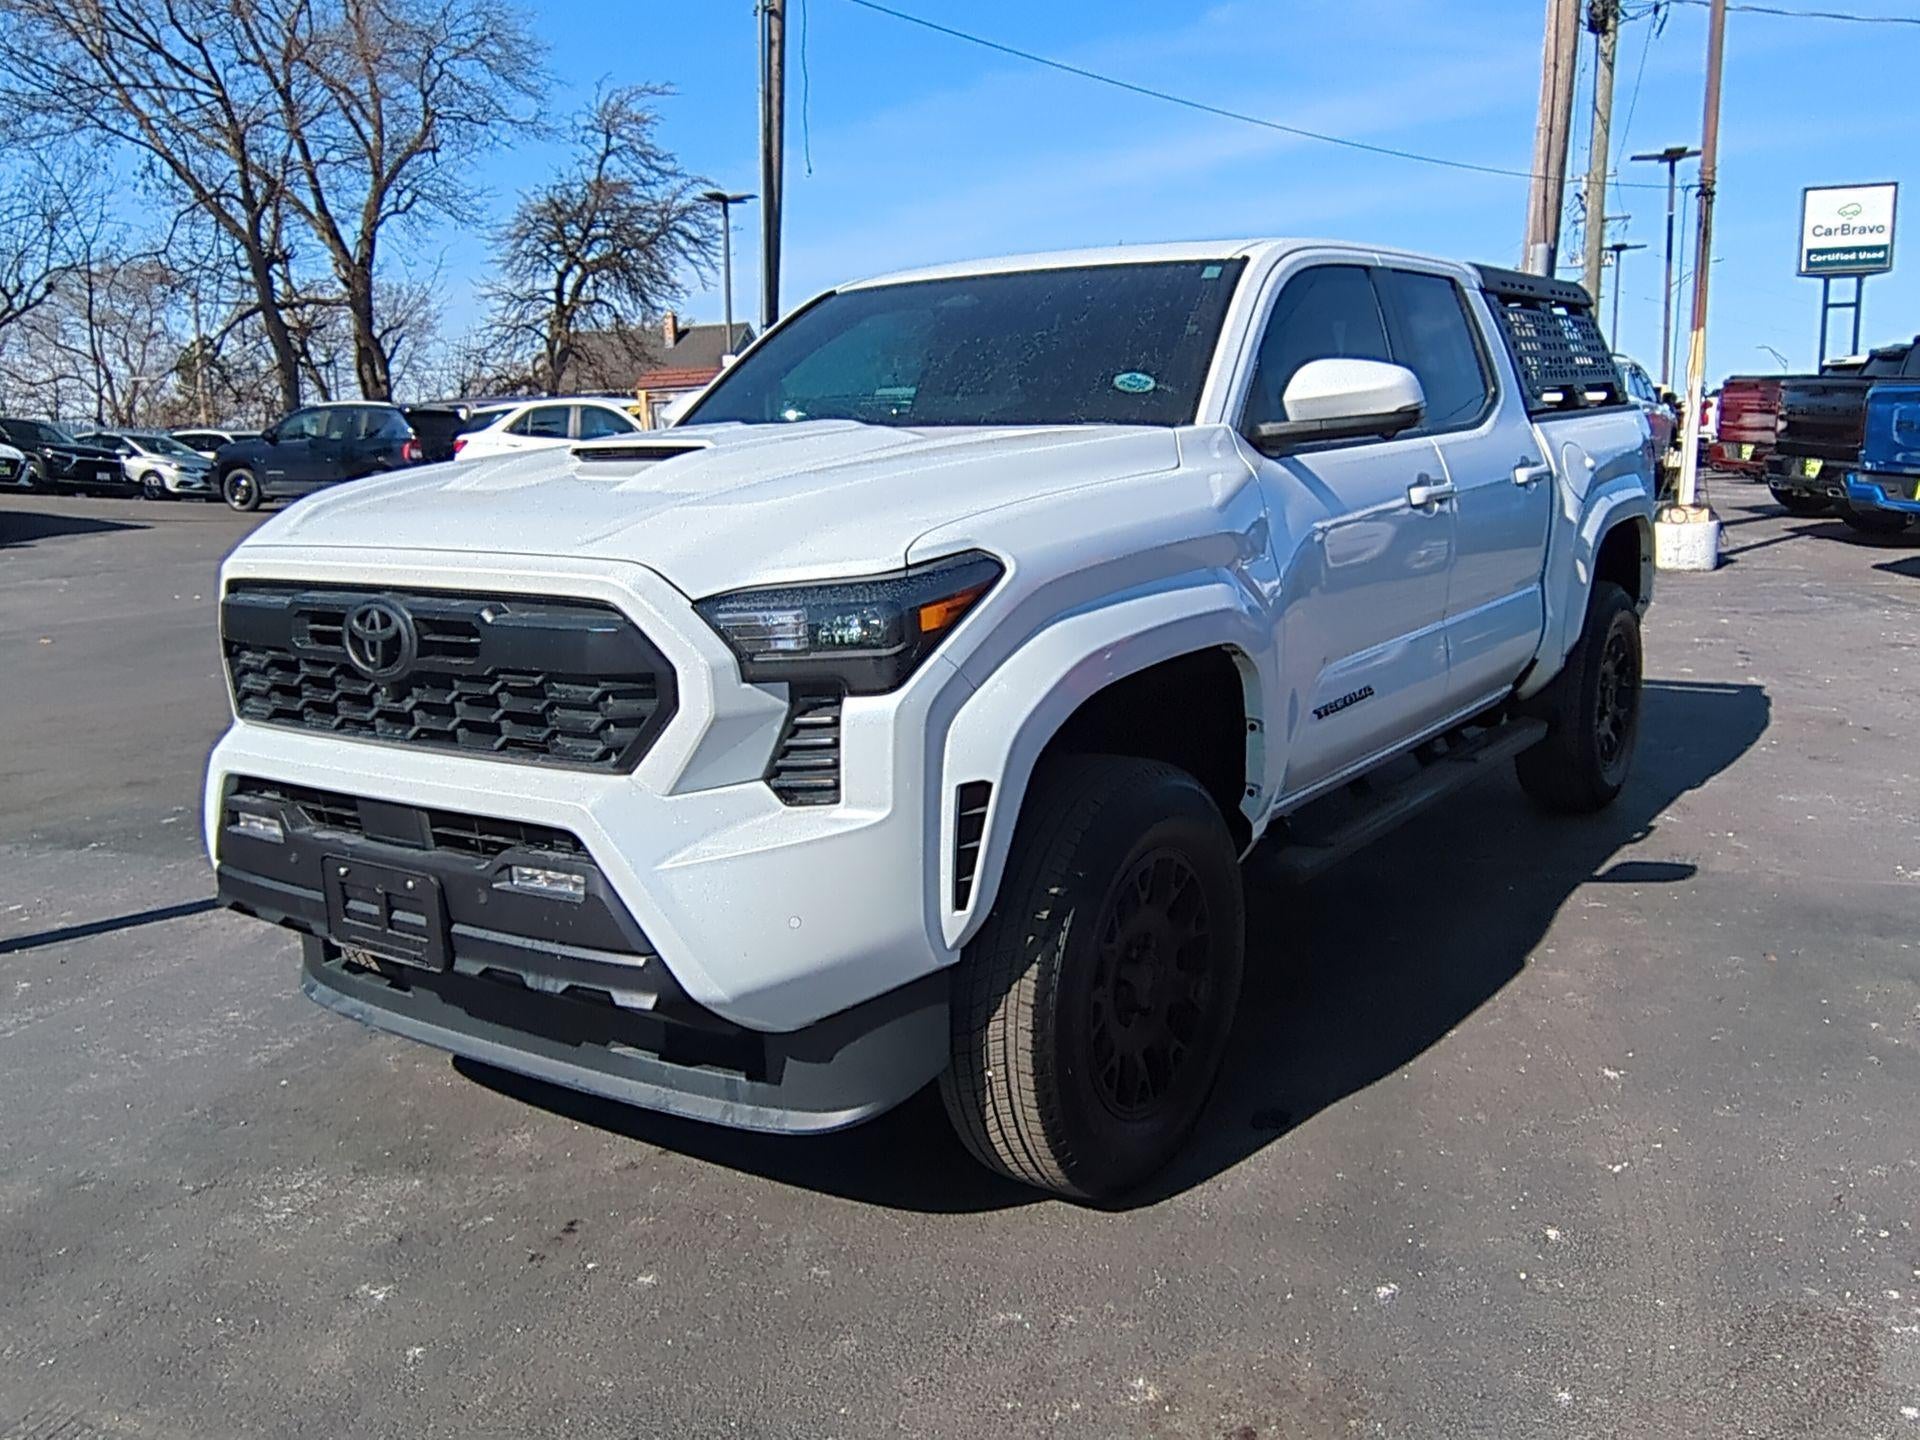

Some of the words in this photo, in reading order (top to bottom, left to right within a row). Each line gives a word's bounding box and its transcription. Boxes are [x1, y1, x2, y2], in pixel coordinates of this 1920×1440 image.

[1812, 223, 1885, 238] CarBravo
[1809, 252, 1856, 262] Certified
[1858, 250, 1885, 260] Used
